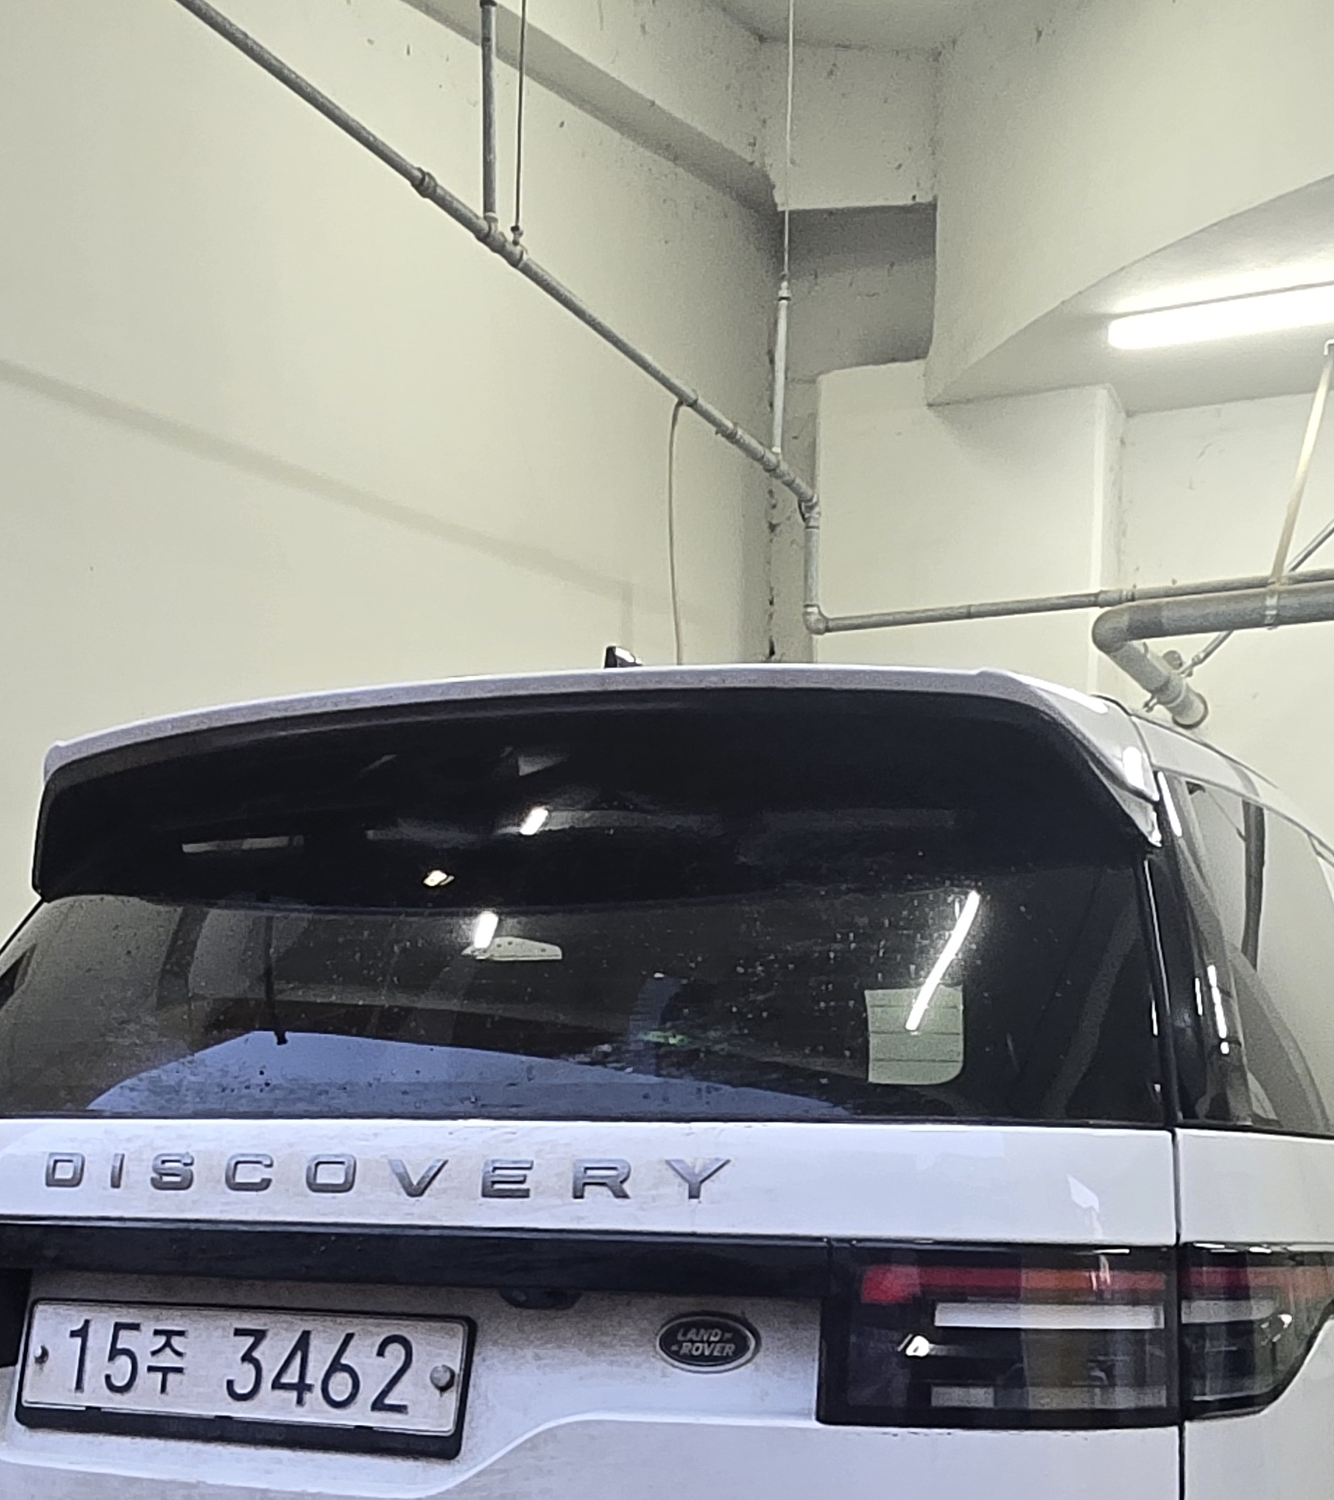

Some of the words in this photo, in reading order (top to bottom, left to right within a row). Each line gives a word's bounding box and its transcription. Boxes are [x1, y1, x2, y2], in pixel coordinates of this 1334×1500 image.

[44, 1151, 731, 1201] DISCOVERY
[676, 1328, 723, 1342] LAND
[679, 1342, 736, 1356] ROVER
[69, 1318, 187, 1395] 15주
[225, 1326, 414, 1415] 3462
